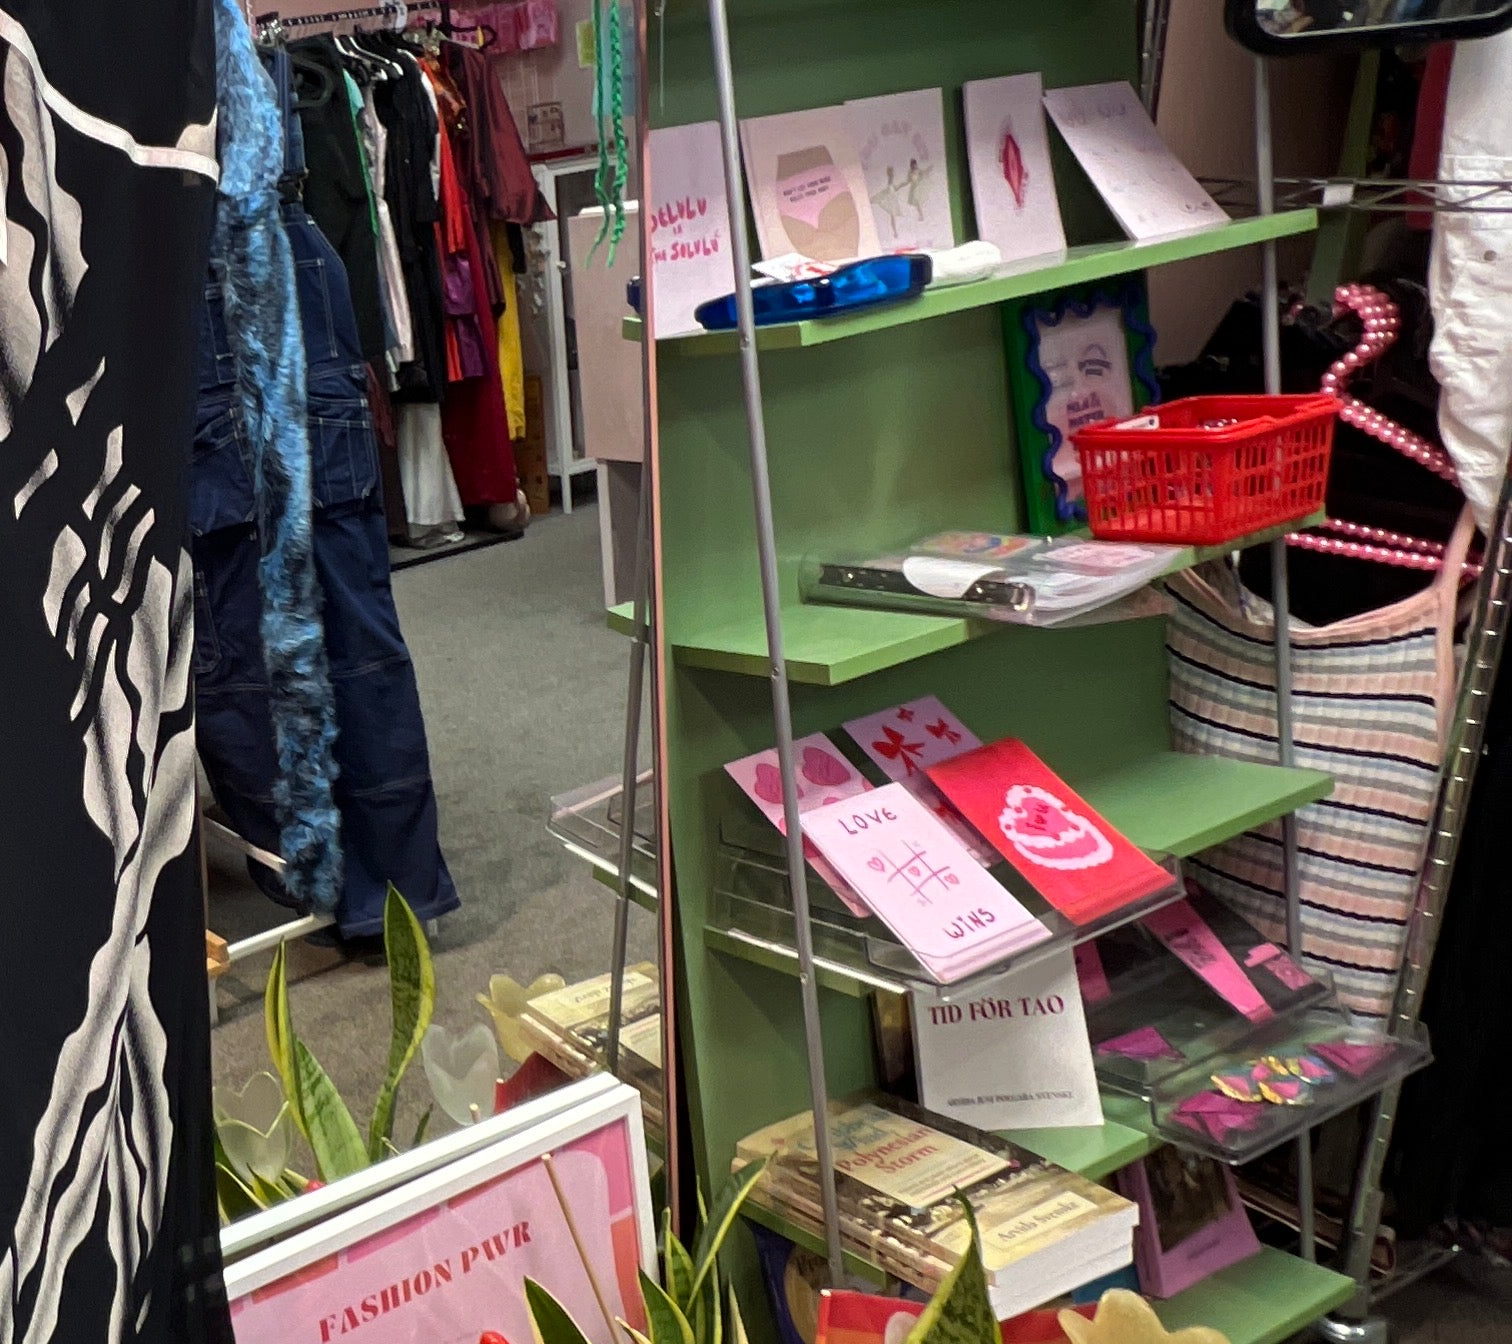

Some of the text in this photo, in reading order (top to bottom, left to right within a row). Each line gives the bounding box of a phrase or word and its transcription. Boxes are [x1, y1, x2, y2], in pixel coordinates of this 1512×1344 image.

[838, 807, 898, 836] LOVE
[929, 994, 1065, 1025] TID FÖR TAO
[837, 1125, 935, 1172] Polynesian
[874, 1144, 939, 1175] Storm
[460, 1220, 532, 1275] PWR
